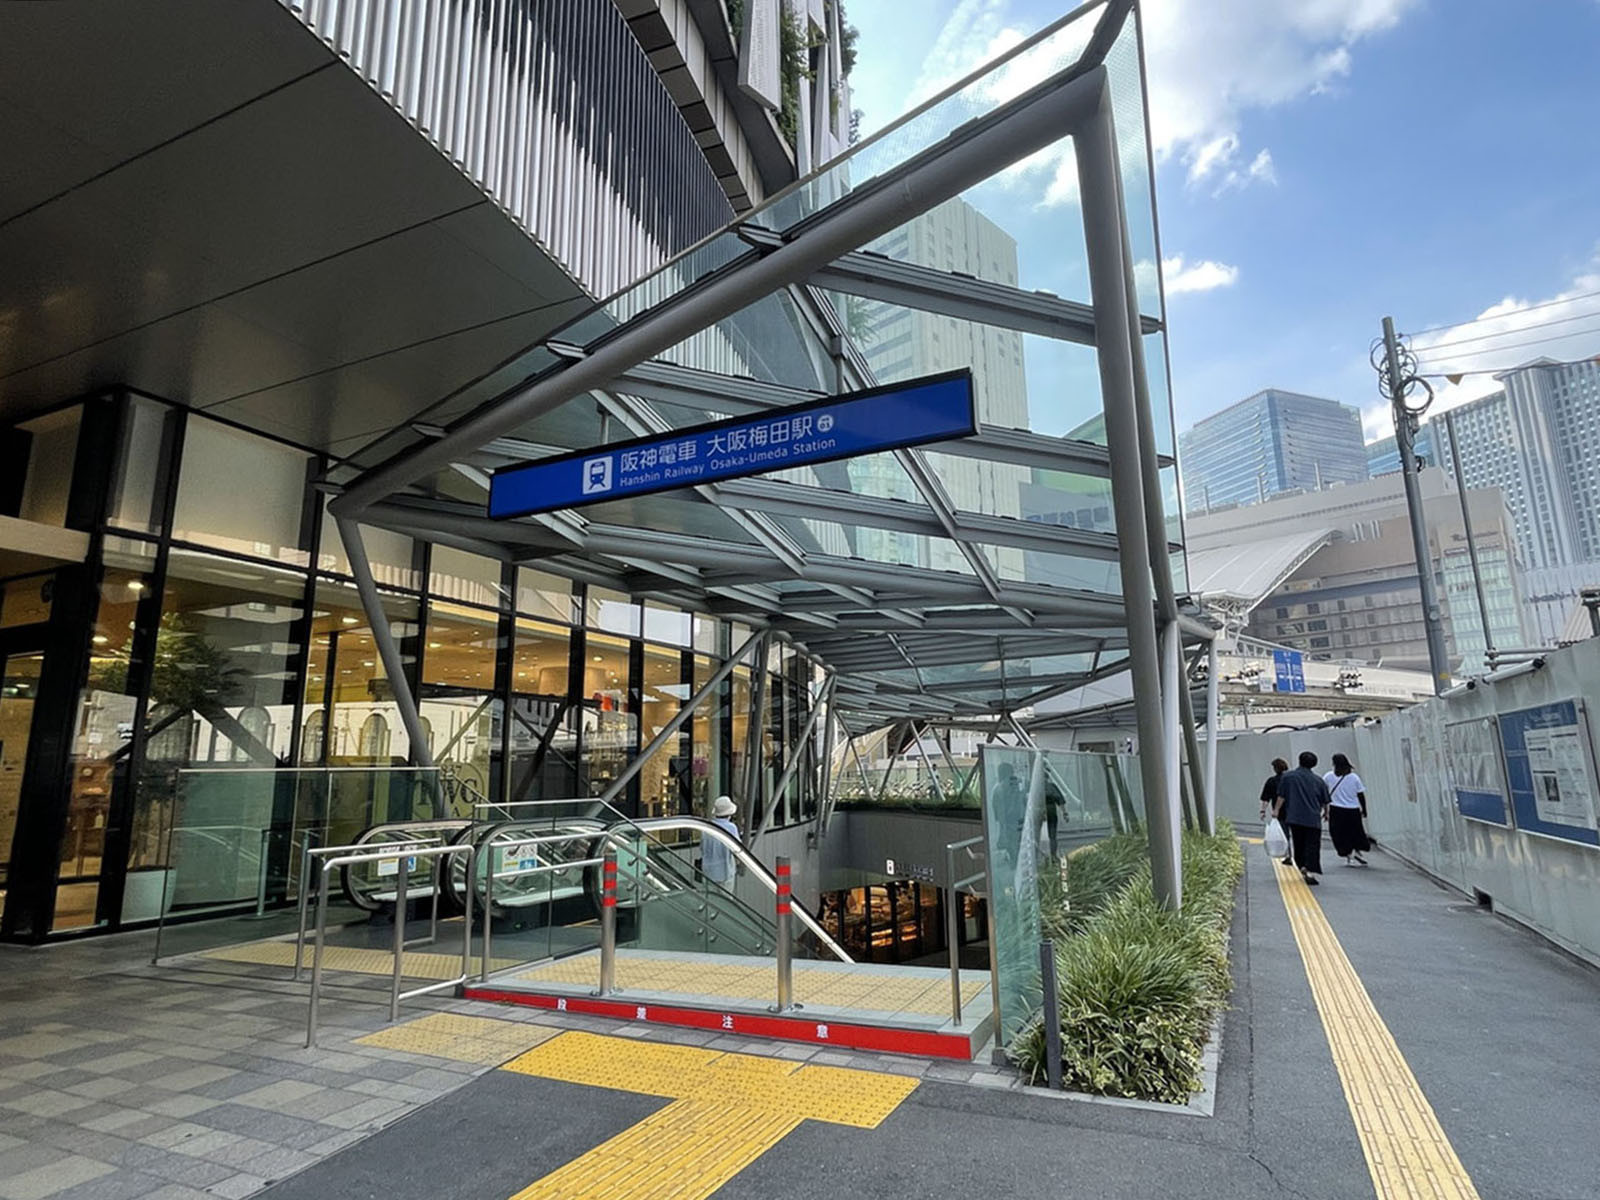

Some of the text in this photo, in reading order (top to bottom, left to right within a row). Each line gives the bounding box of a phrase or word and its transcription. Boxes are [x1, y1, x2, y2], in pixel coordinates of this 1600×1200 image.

[620, 440, 697, 473] 阪神電車
[706, 415, 813, 457] 大阪梅田駅
[620, 438, 836, 487] Hanshin Railway Osaka-Umeda Station
